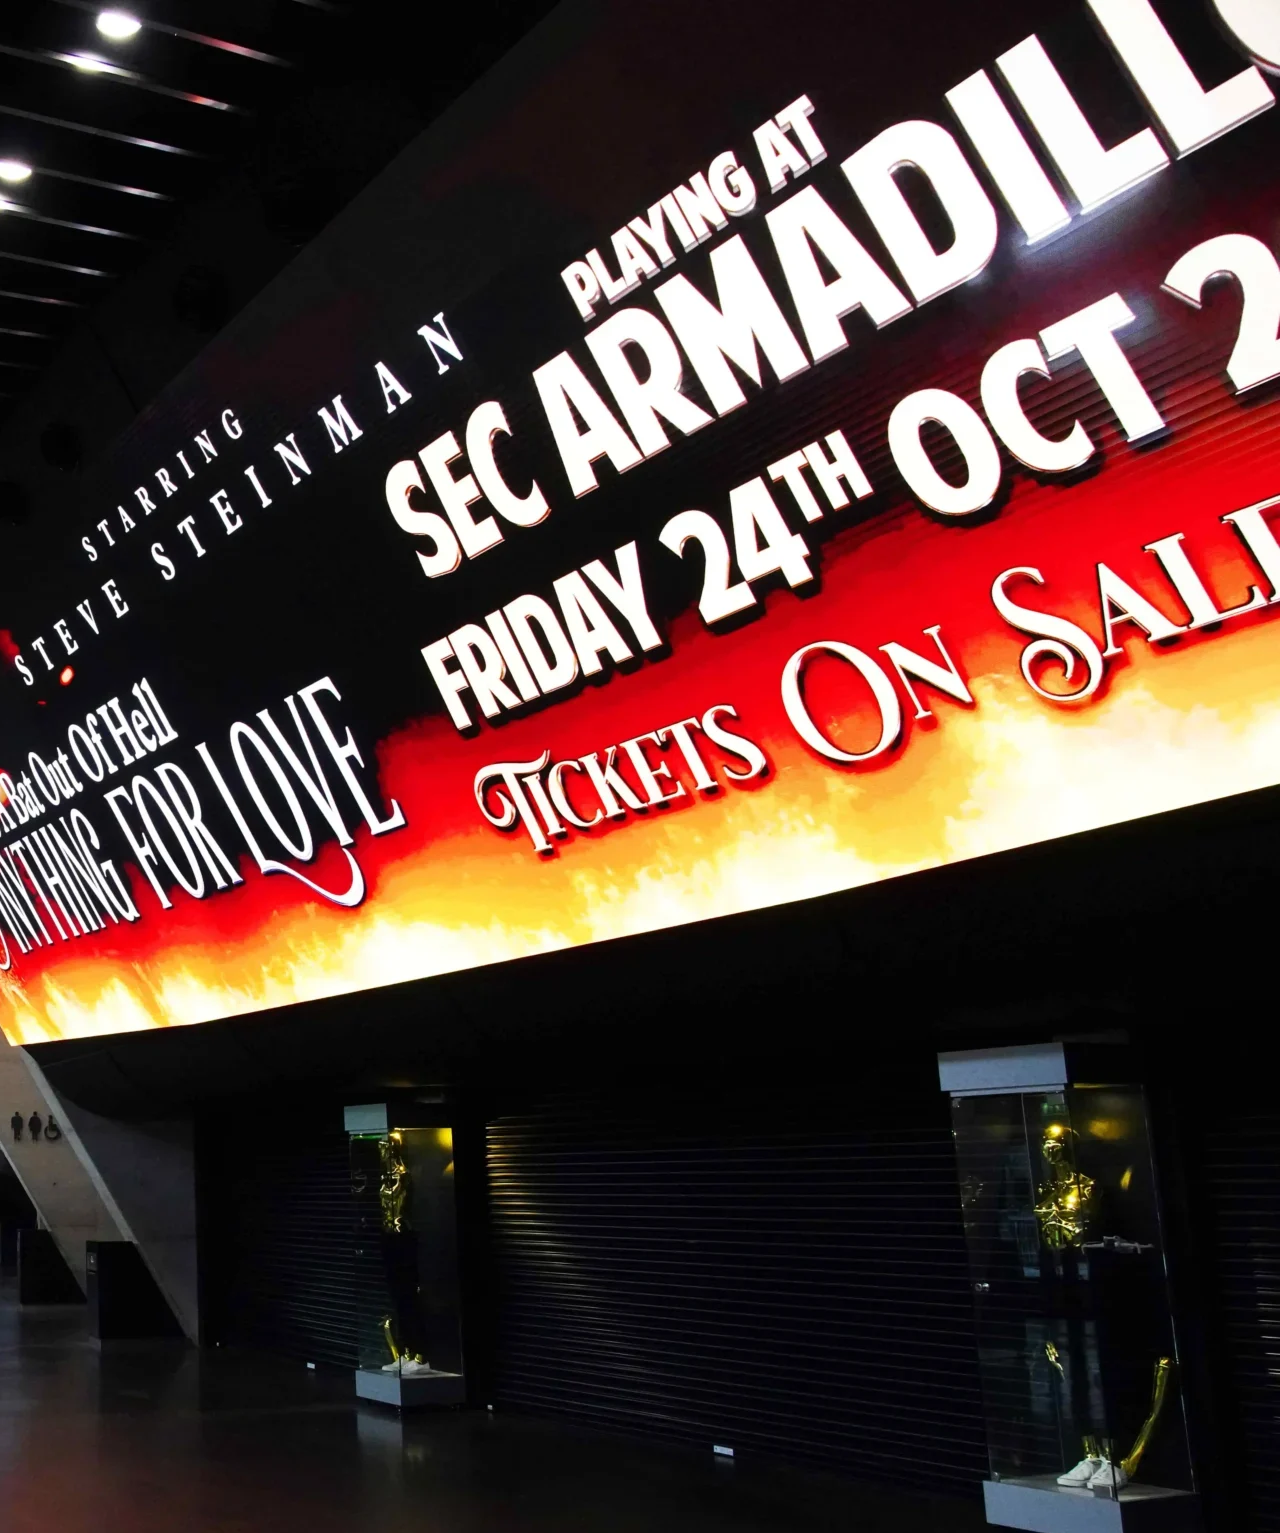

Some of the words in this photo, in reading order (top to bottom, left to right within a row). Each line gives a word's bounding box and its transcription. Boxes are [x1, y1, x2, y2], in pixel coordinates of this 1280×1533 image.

[385, 400, 551, 579] SEC
[532, 0, 1280, 499] ARMADILL
[560, 150, 757, 322] PLAYING
[752, 94, 828, 194] AT
[14, 579, 129, 686] STEVE
[151, 312, 464, 580] STEINMAN
[82, 408, 243, 561] STARRING
[420, 540, 662, 732] FRIDAY
[658, 429, 874, 626] 24TH
[887, 292, 1166, 517] OCT
[28, 746, 84, 806] Out
[68, 713, 119, 782] Of
[96, 677, 179, 766] Hell
[103, 762, 244, 909] FOR
[195, 676, 407, 906] LOVE
[473, 703, 768, 853] TICKETS
